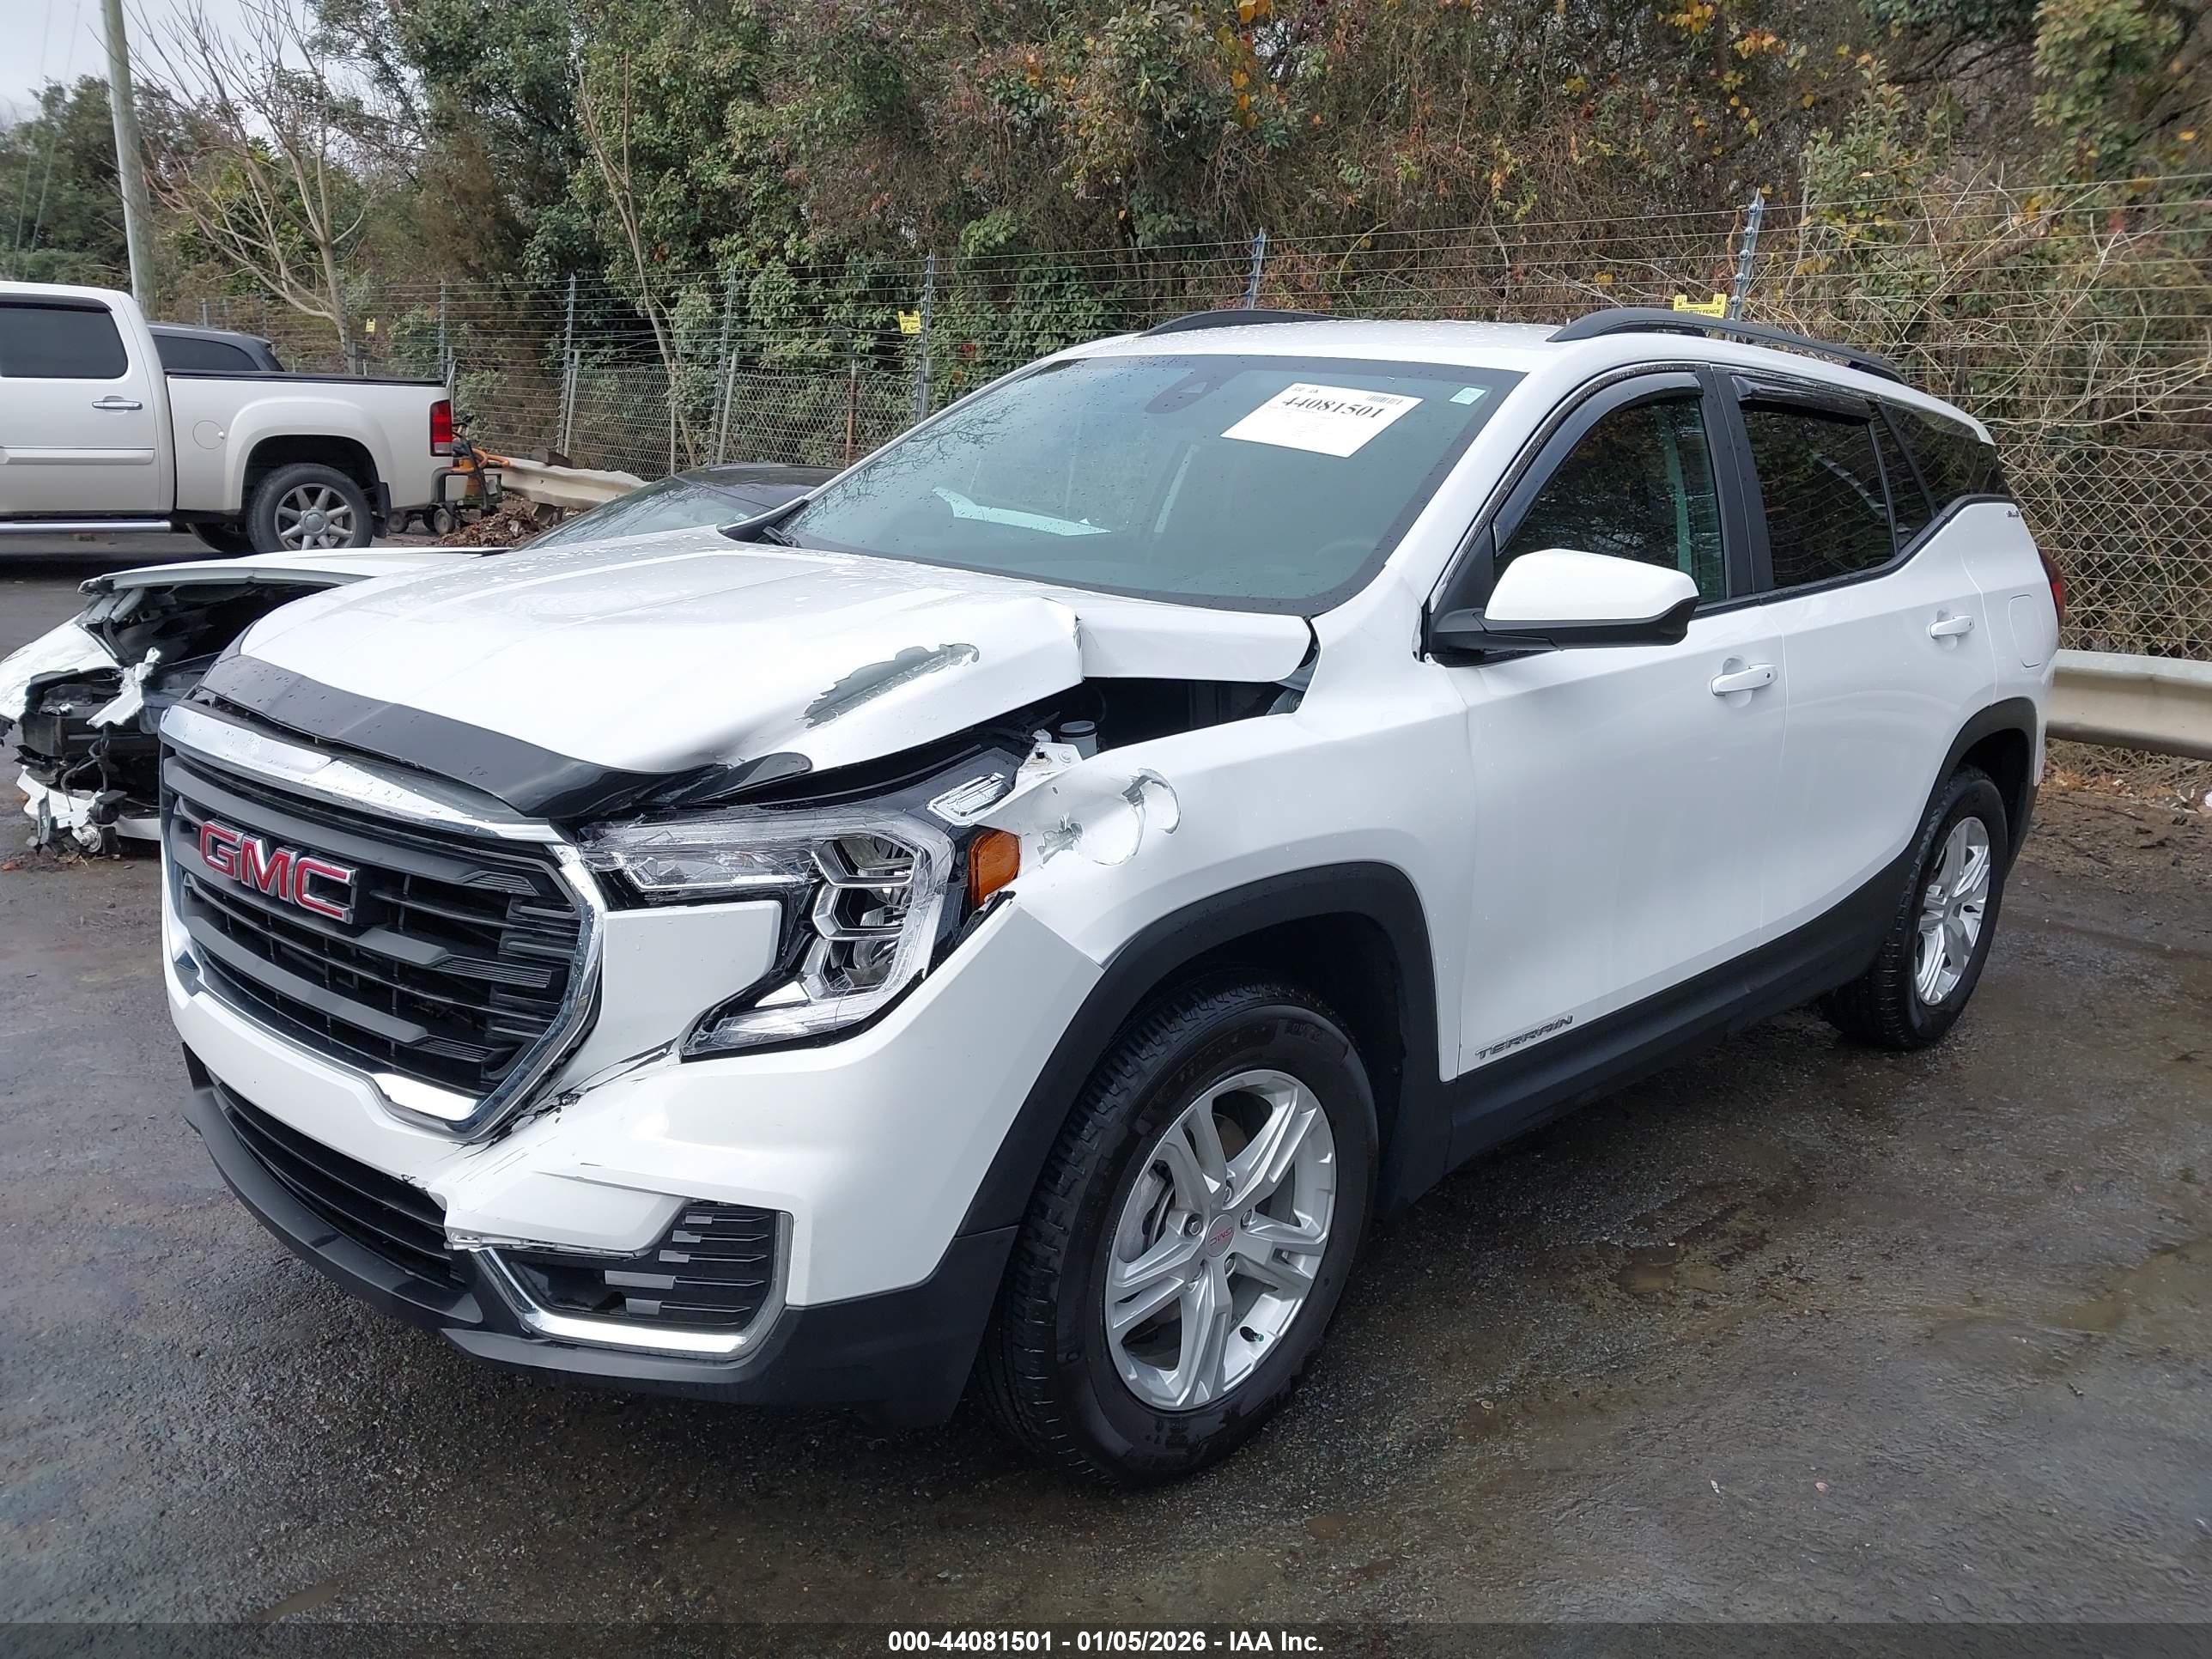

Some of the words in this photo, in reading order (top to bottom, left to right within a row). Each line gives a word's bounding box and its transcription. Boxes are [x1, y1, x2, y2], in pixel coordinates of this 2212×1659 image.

[1283, 396, 1385, 418] 44081501
[199, 820, 358, 925] GMC
[1474, 1013, 1573, 1060] TERRAIN
